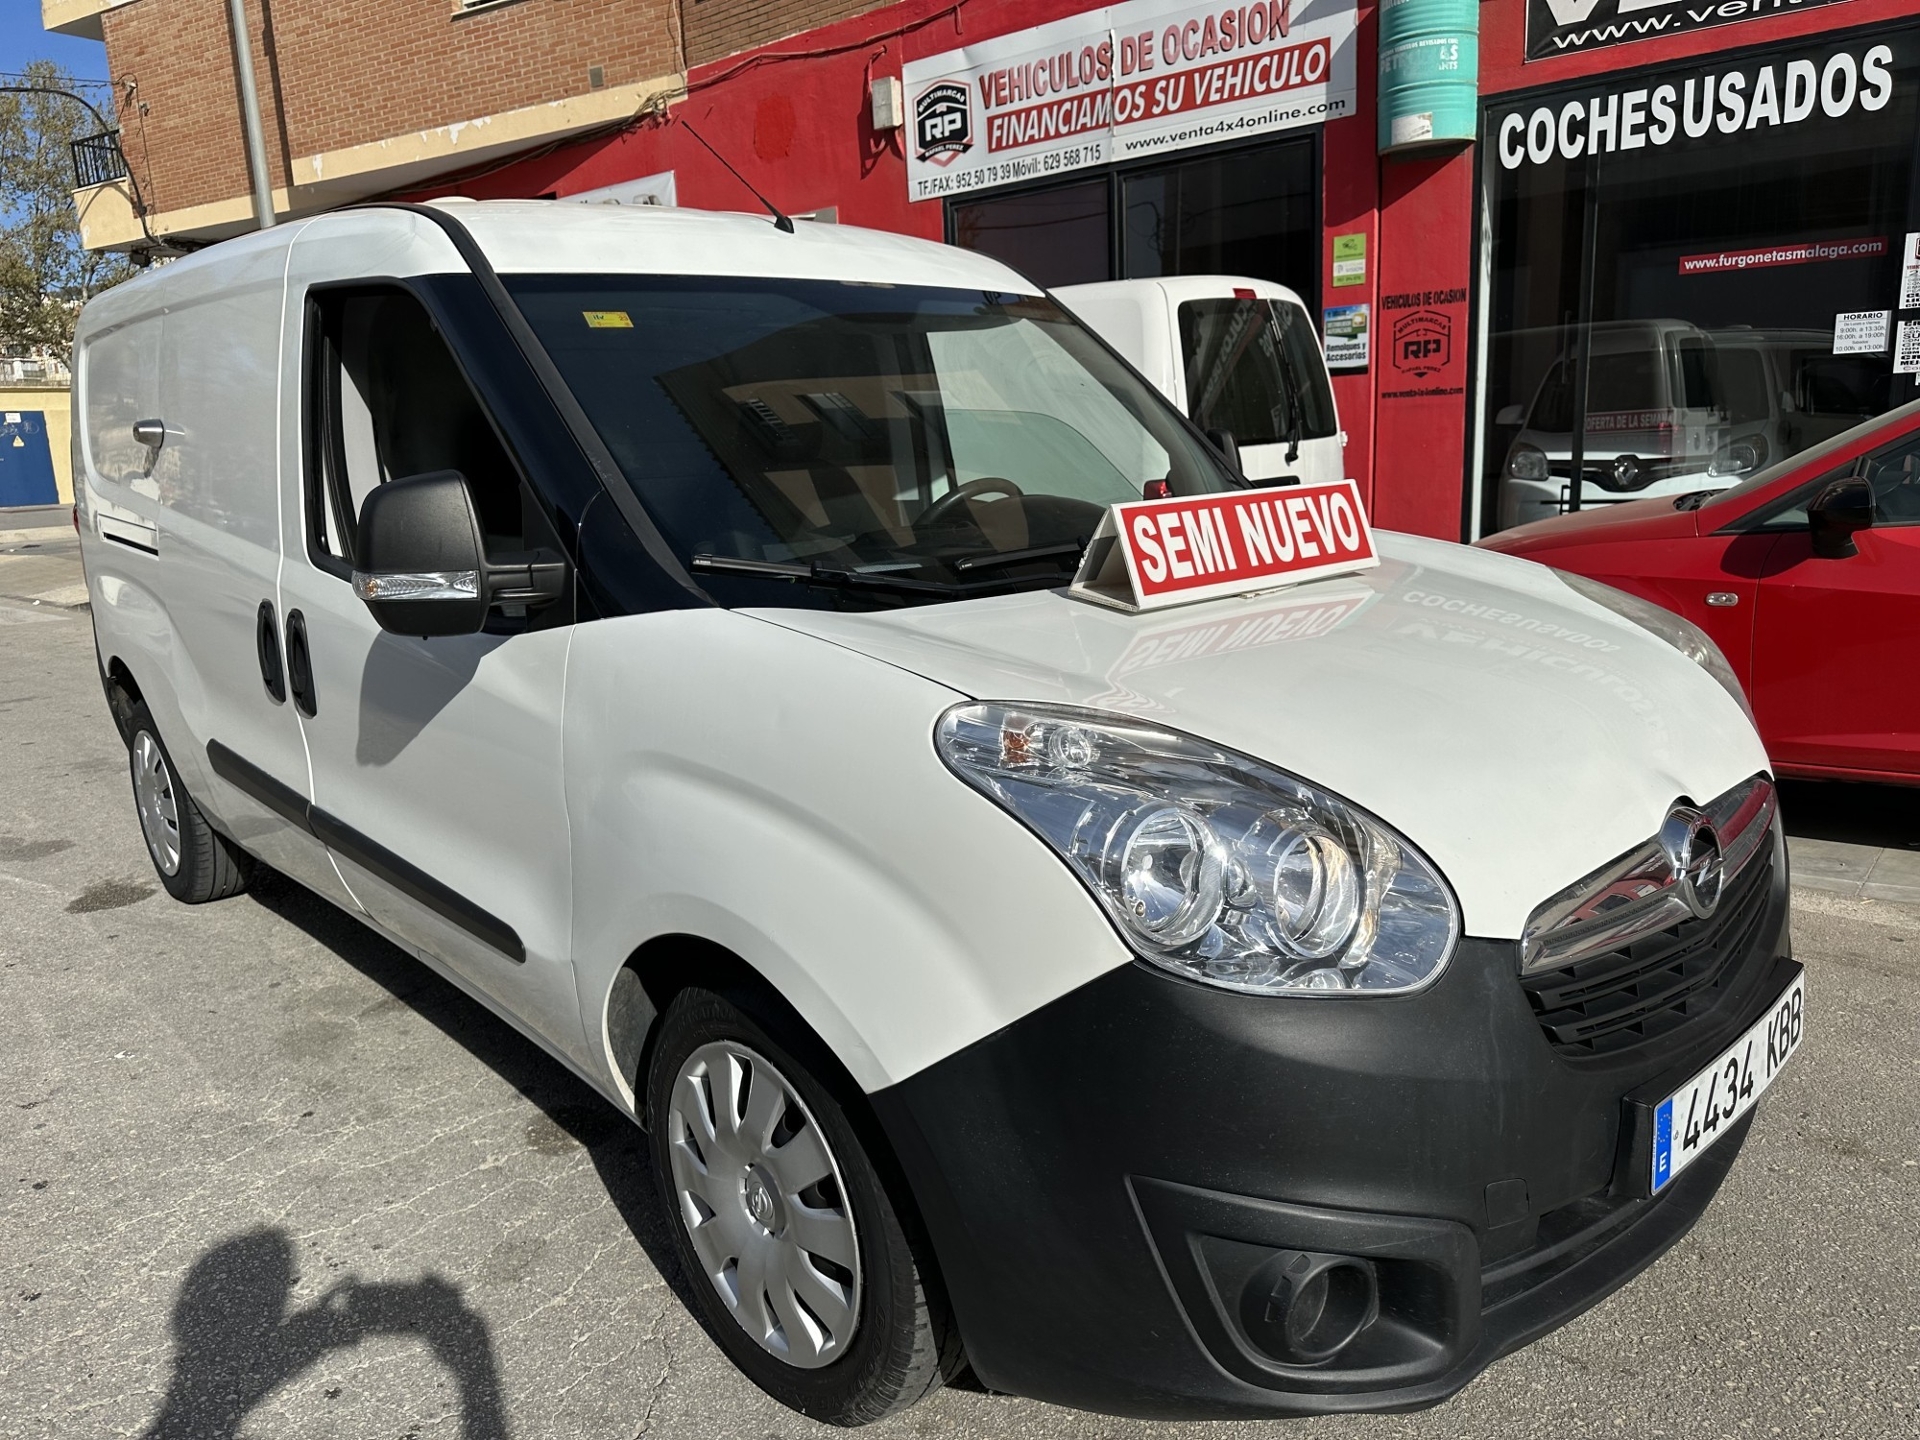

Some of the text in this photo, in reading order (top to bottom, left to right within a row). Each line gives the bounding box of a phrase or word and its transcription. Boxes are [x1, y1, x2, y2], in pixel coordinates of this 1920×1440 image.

[979, 0, 1290, 110] VEHICULOS DE OCASION
[918, 89, 965, 113] MULTIMARCAS
[992, 44, 1326, 149] FINANCIAMOS SU VEHICULO
[924, 111, 962, 141] RP
[1125, 99, 1346, 151] www.venta4x4online.com
[956, 171, 972, 189] 952
[974, 169, 985, 185] 50
[987, 166, 998, 183] 79
[1000, 163, 1011, 180] 39
[1012, 158, 1041, 179] Móvil:
[1043, 153, 1061, 171] 629
[1063, 149, 1080, 168] 568
[1083, 144, 1101, 163] 715
[1685, 242, 1883, 270] www.furgonetasmalaga.com
[1381, 288, 1467, 310] VEHICULOS DE OCASION
[1397, 317, 1446, 334] MULTIMARCAS
[1843, 312, 1883, 320] HORARIO
[1326, 342, 1360, 352] Remolques
[1326, 351, 1366, 362] Accesorios
[1404, 338, 1441, 360] RP
[1587, 417, 1615, 430] OFERTA
[1616, 415, 1627, 429] DE
[1628, 414, 1639, 428] LA
[1133, 492, 1360, 583] SEMI NUEVO
[1682, 987, 1801, 1151] 4434 KBB
[1658, 1150, 1668, 1173] E
